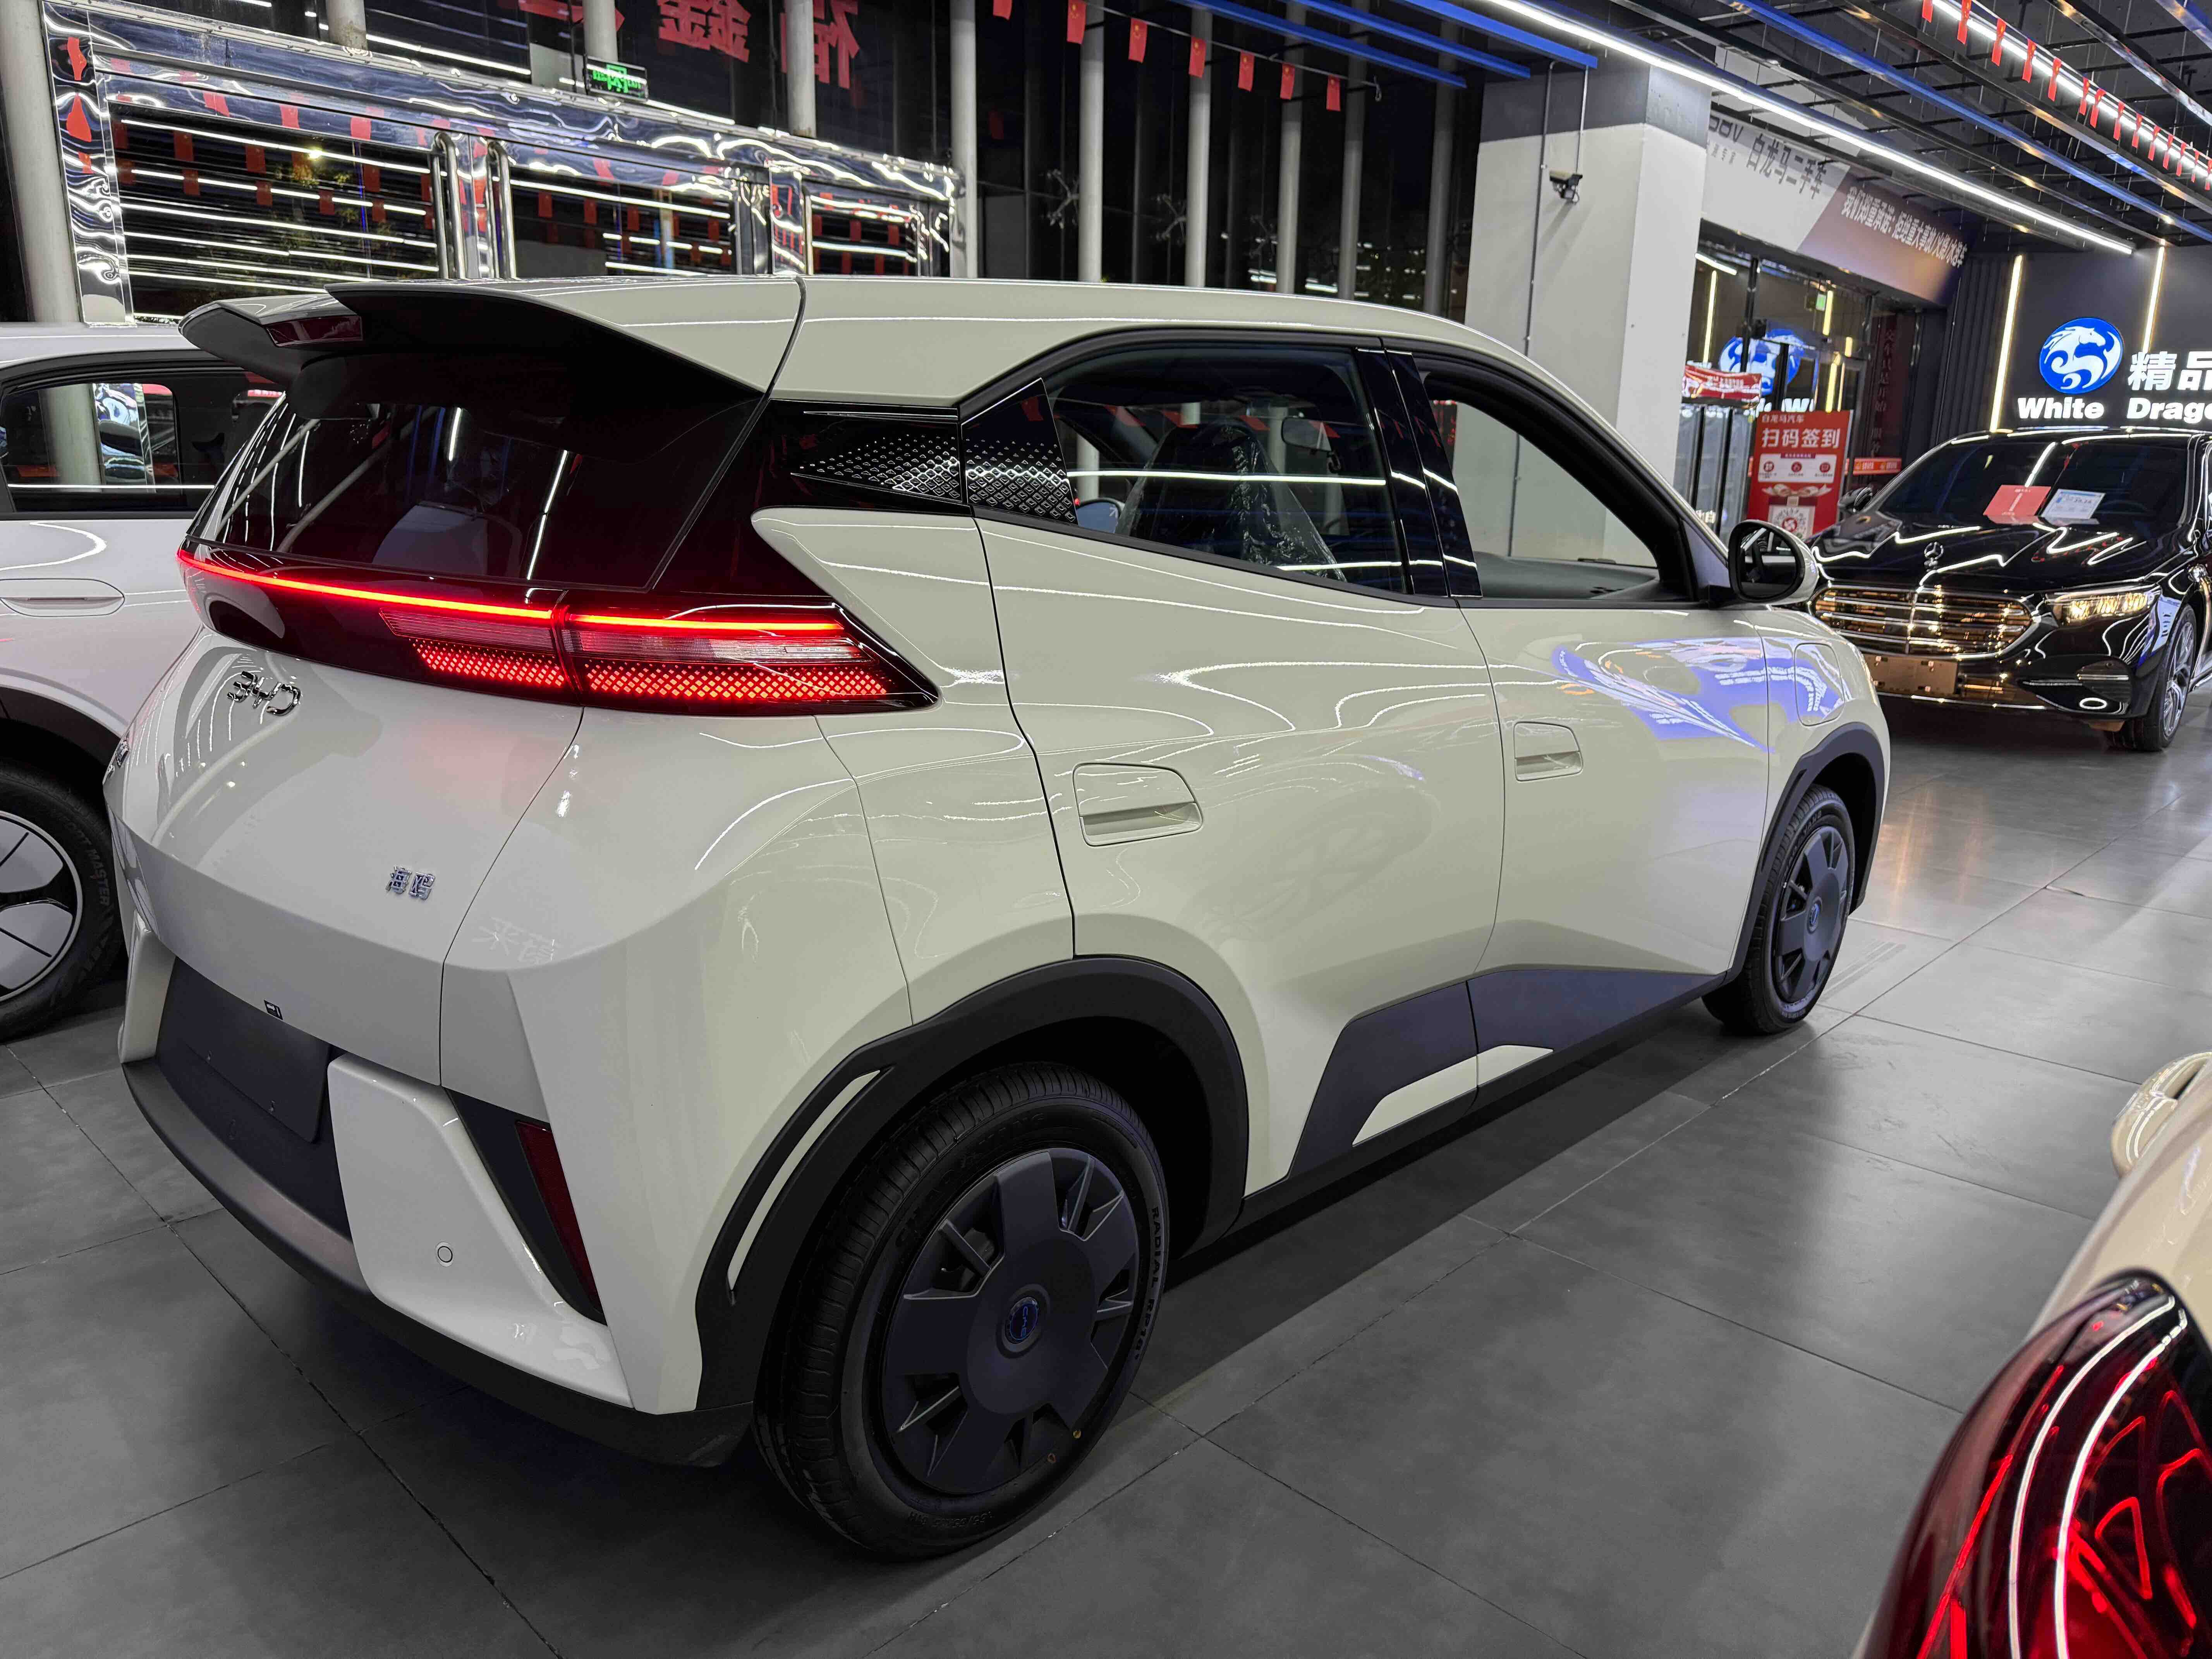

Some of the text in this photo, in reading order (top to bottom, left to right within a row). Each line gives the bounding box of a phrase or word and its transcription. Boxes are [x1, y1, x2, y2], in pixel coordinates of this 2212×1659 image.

[1747, 132, 1827, 200] 白龙马二手车
[2128, 351, 2212, 391] 精品
[1762, 414, 1804, 423] 白龙马汽车
[2017, 397, 2104, 419] White
[1762, 428, 1841, 448] 扫码签到
[227, 671, 301, 716] BYD
[385, 864, 435, 900] 海鸥
[1151, 1205, 1161, 1288] RADIAL
